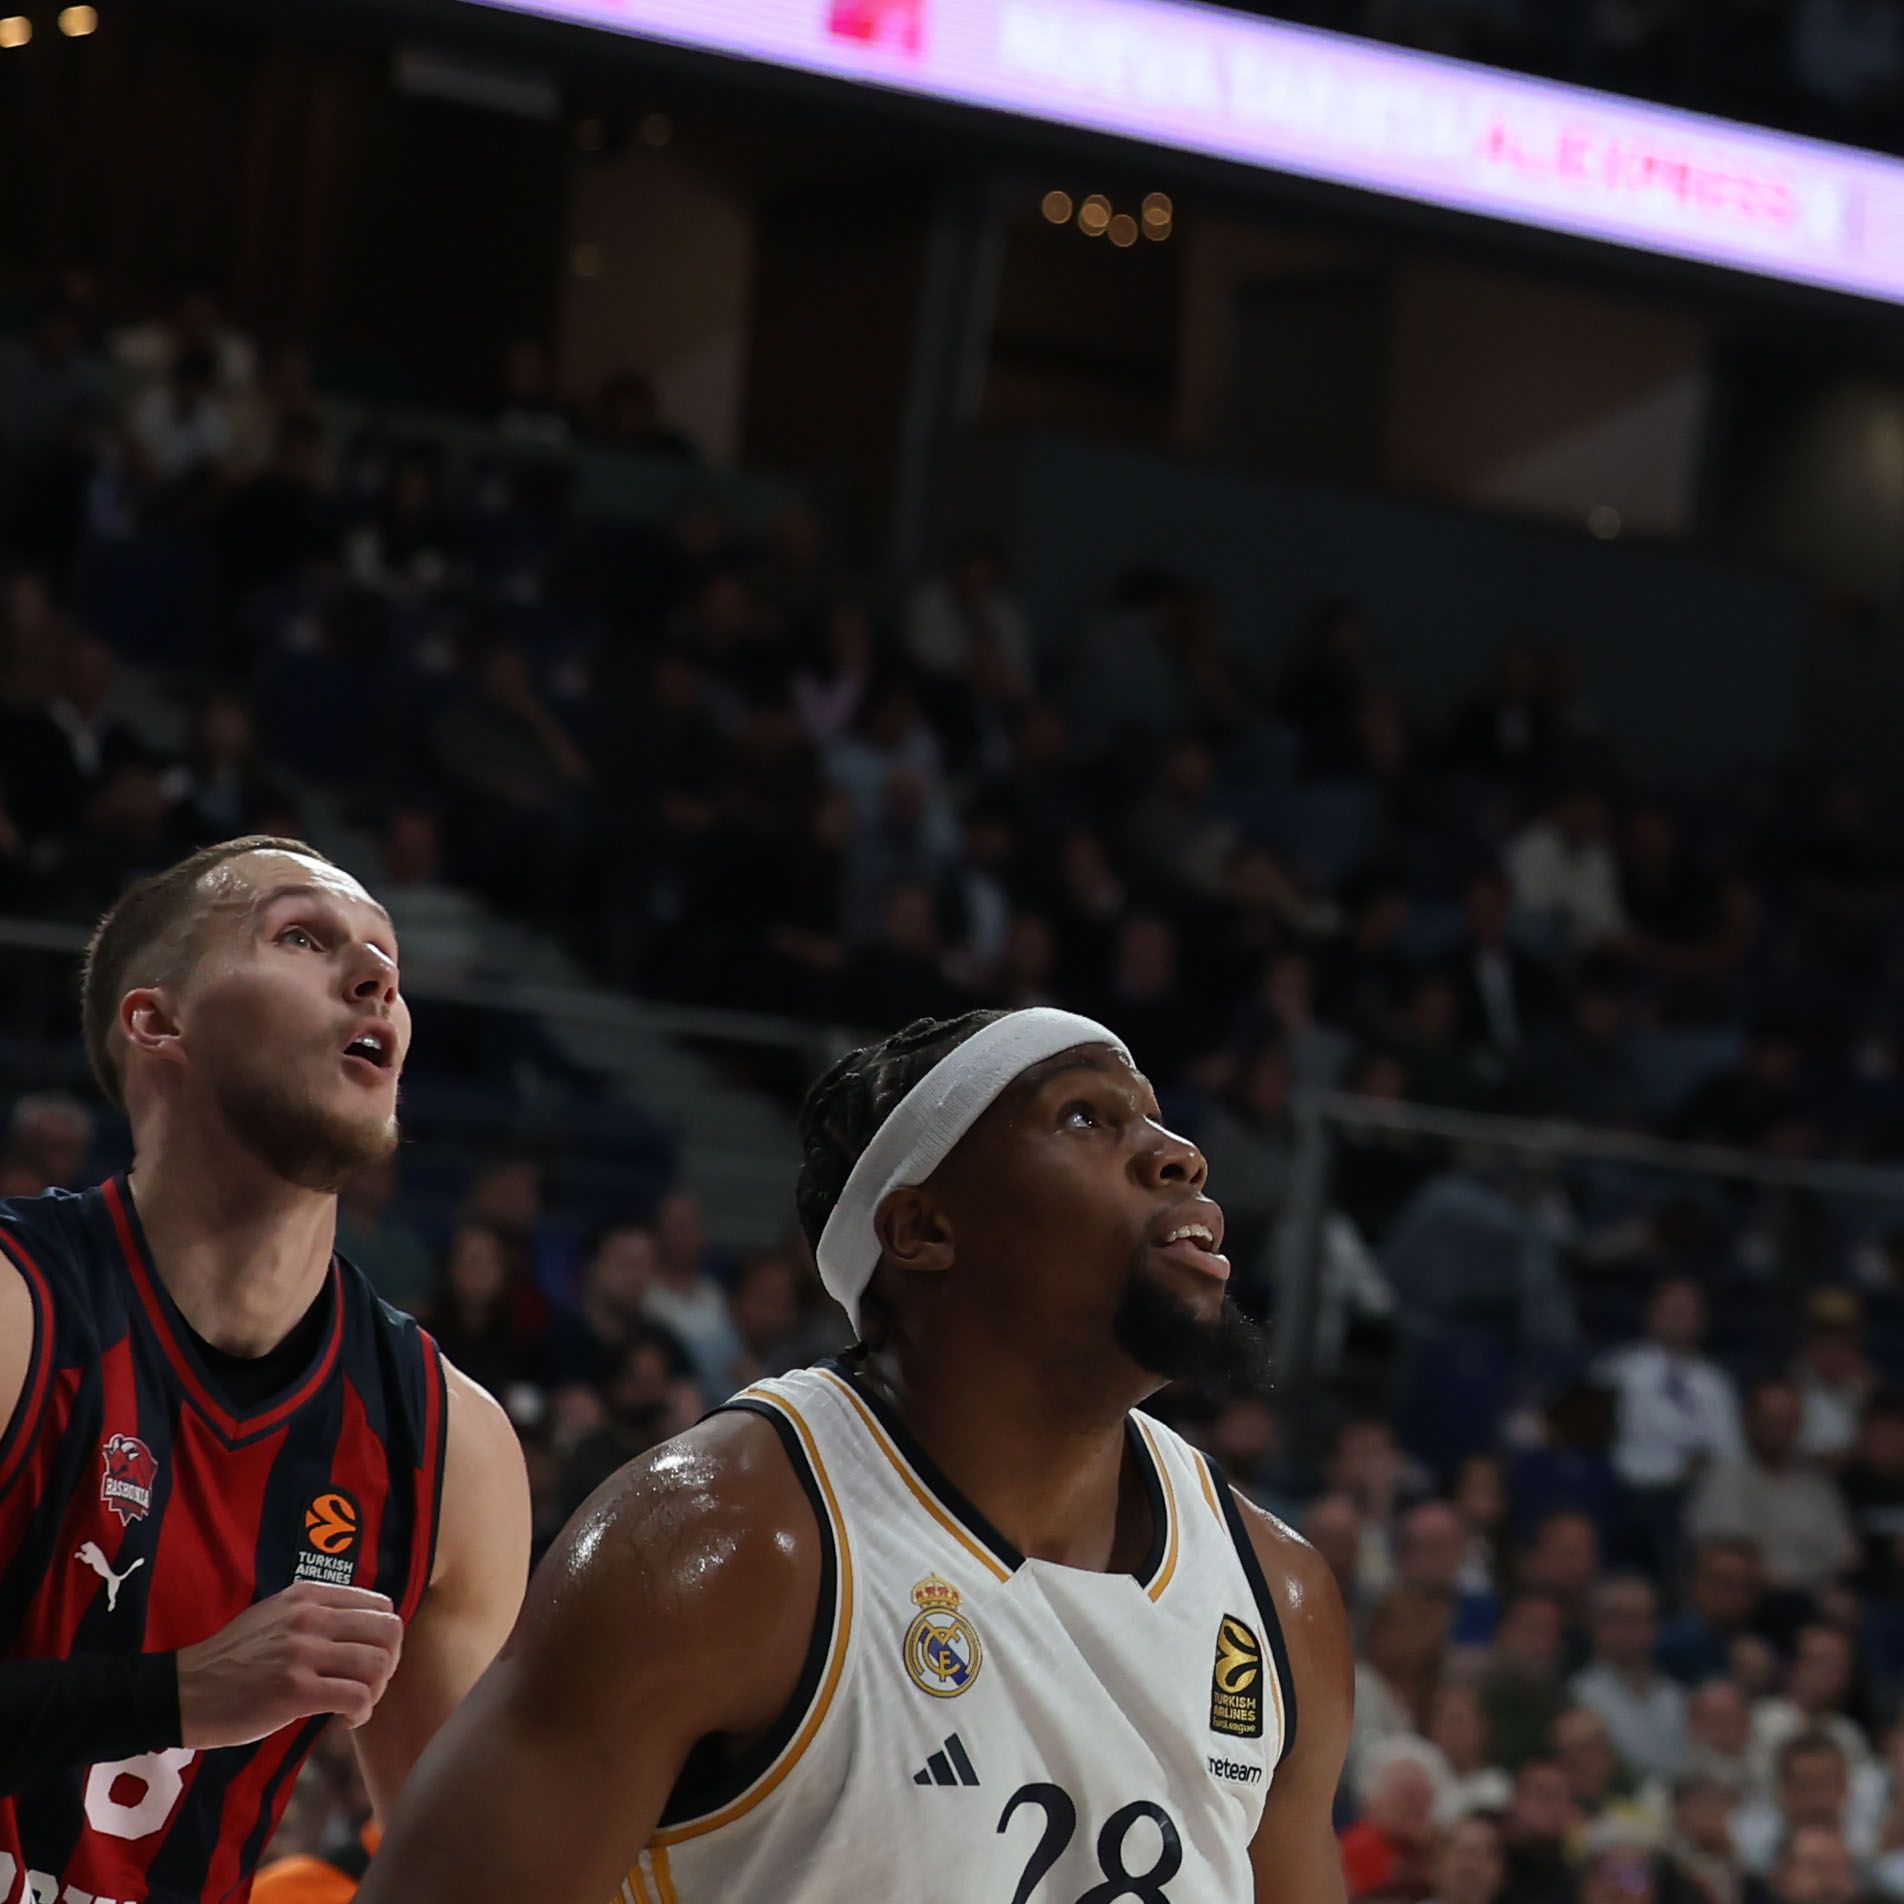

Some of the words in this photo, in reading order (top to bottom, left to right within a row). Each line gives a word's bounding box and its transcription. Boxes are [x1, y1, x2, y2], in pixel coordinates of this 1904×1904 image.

[294, 1562, 352, 1586] AIRLINES
[299, 1551, 354, 1574] TURKISH
[1214, 1691, 1257, 1710] TURKISH
[1213, 1704, 1257, 1722] AIRLINES
[996, 1782, 1183, 1904] 28
